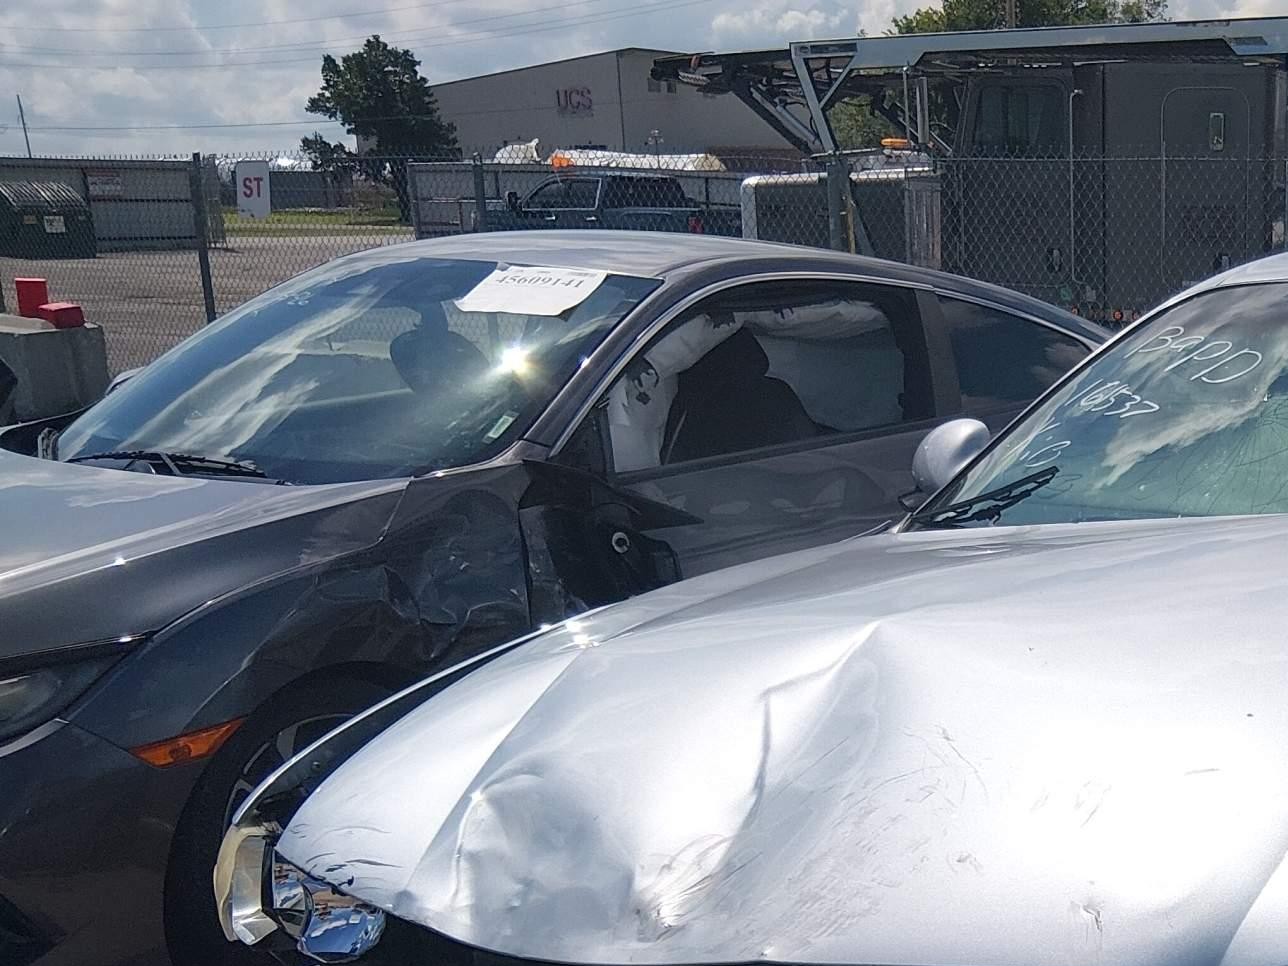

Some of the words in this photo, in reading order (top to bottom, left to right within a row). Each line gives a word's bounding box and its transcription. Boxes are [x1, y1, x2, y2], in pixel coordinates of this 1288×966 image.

[556, 87, 593, 110] UCS
[242, 176, 264, 198] ST
[496, 274, 585, 289] 45609141
